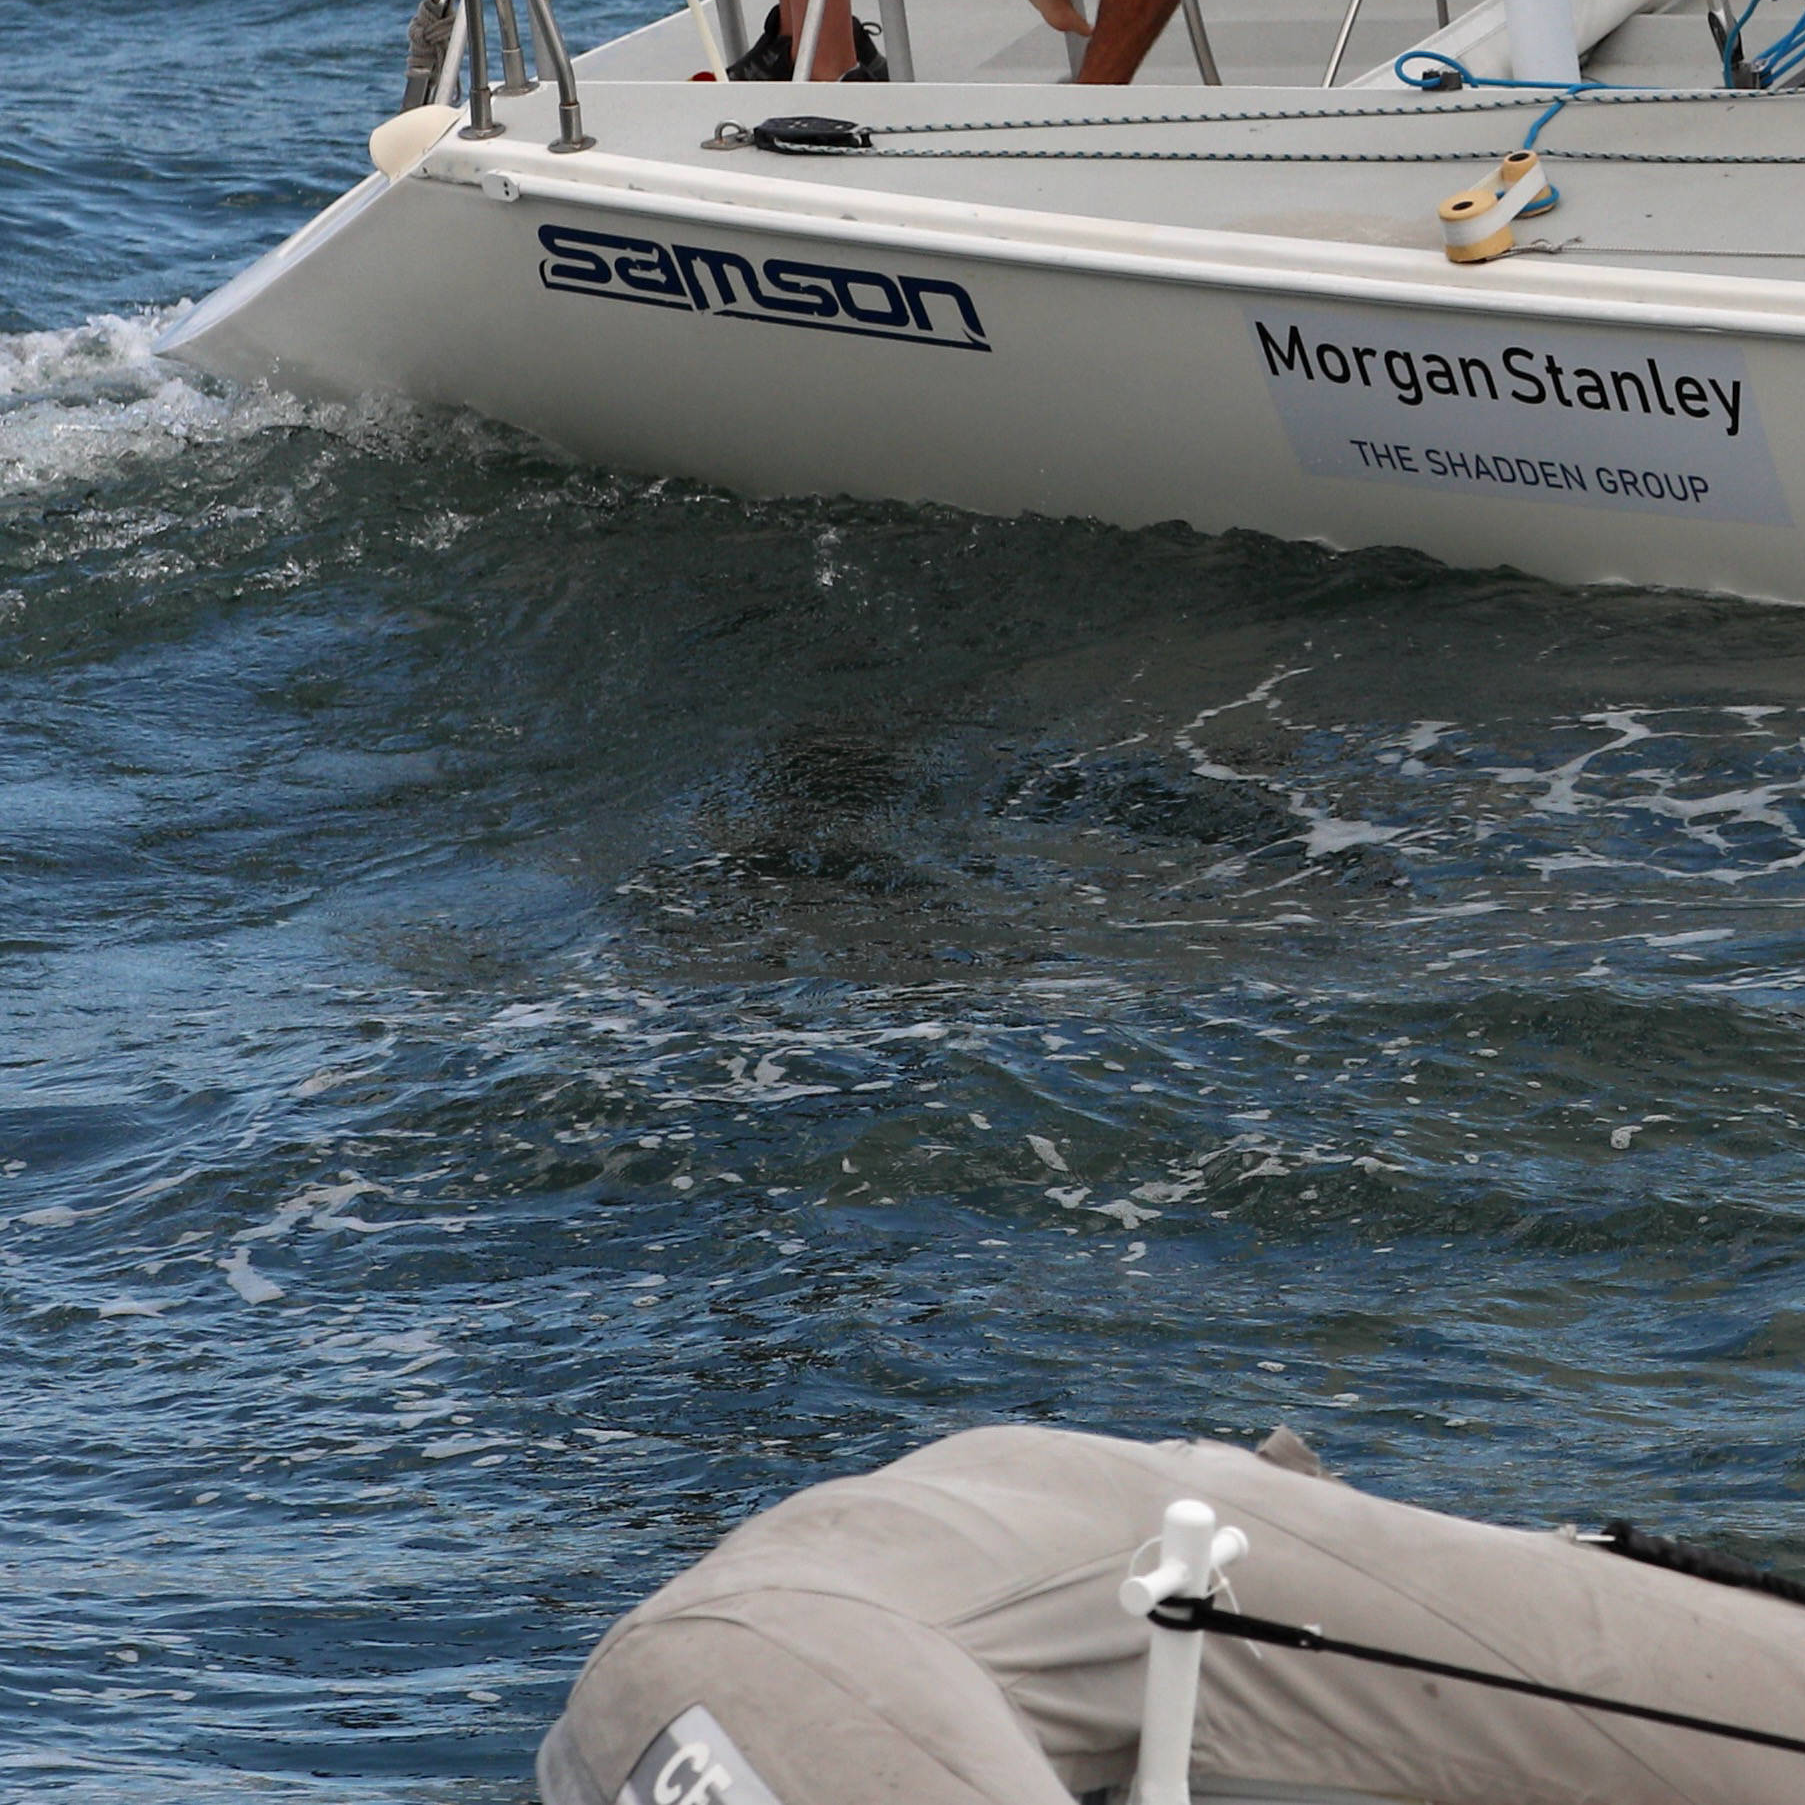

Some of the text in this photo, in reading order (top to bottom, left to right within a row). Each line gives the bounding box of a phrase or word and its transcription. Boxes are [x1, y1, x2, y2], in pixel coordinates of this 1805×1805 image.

[1254, 320, 1742, 437] Morgan Stanley
[1350, 439, 1709, 504] THE SHADDEN GROUP
